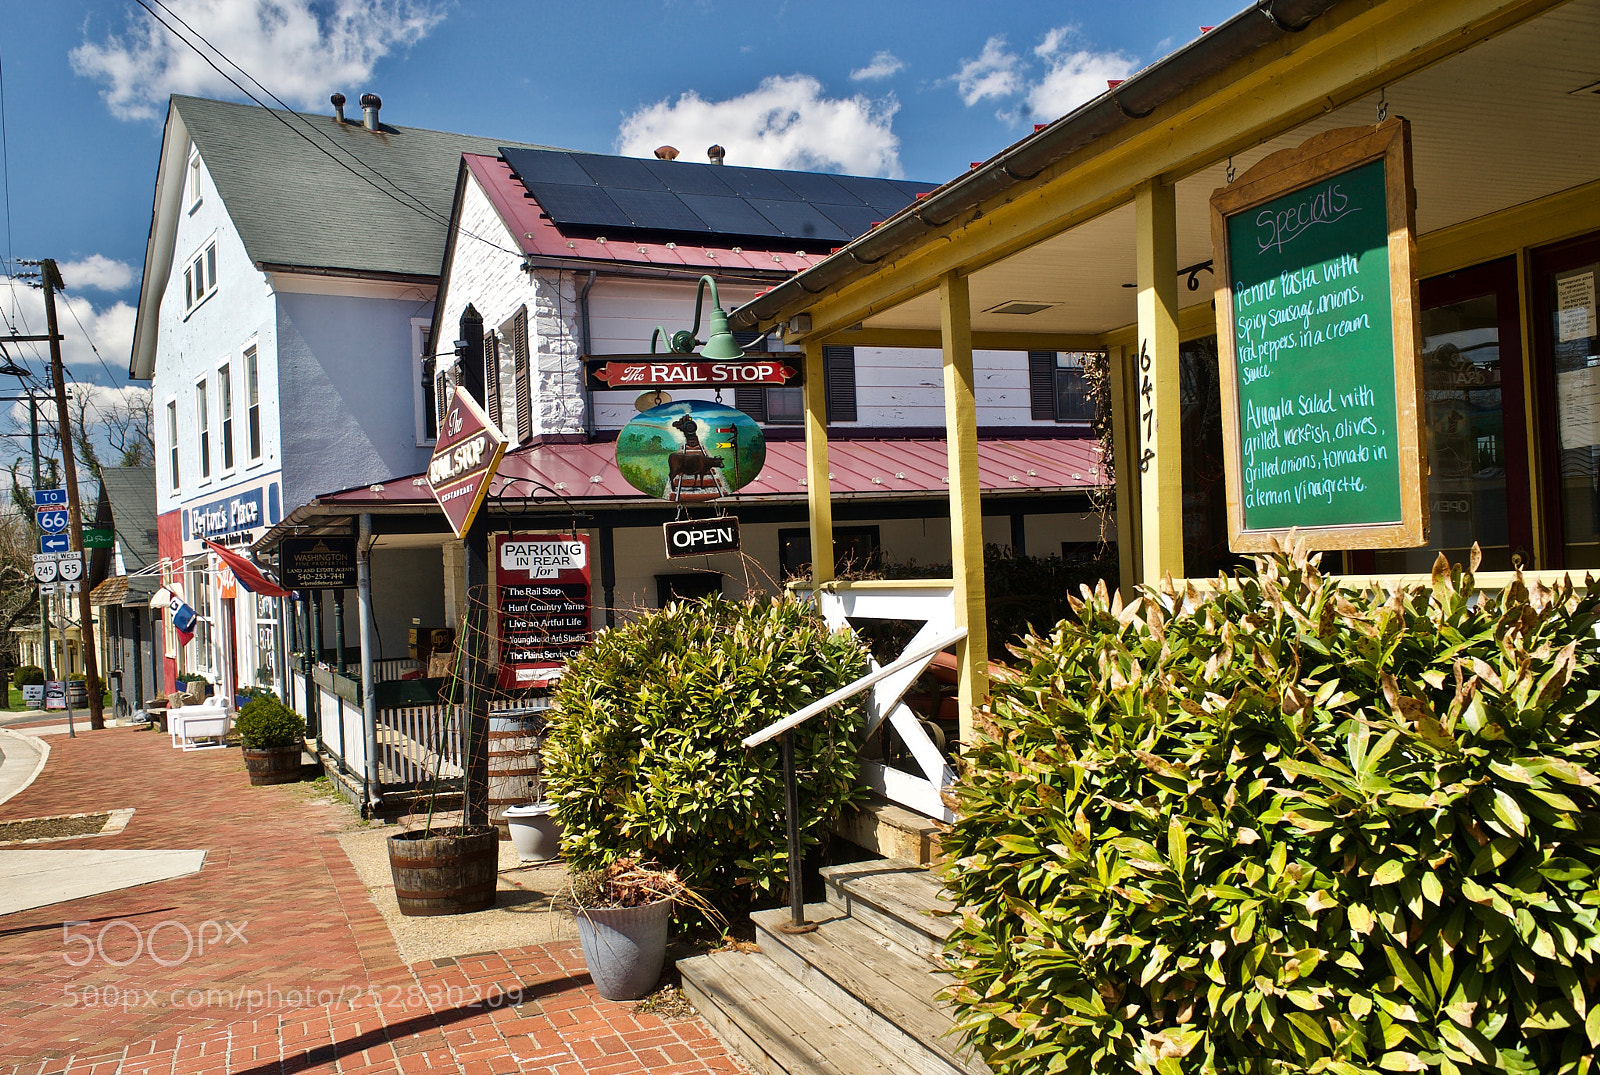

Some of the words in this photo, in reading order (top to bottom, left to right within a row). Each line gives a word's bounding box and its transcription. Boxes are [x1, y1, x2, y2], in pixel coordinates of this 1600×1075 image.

[1255, 183, 1349, 254] Specials
[1236, 281, 1276, 312] Penne
[1279, 269, 1320, 298] Pasta
[1322, 252, 1359, 282] with
[1319, 286, 1364, 314] onions,
[1238, 340, 1258, 364] red
[1300, 331, 1313, 348] in
[1313, 330, 1325, 345] a
[1325, 313, 1371, 340] cream
[620, 366, 647, 383] The
[650, 364, 707, 383] RAIL
[711, 364, 774, 382] STOP
[1139, 338, 1155, 473] 6478
[1246, 397, 1294, 432] Arugula
[1340, 384, 1375, 408] with
[448, 407, 464, 438] The
[454, 436, 487, 474] STOP
[1244, 427, 1281, 467] grilled
[1245, 456, 1279, 491] grilled
[1280, 454, 1321, 475] onions,
[1322, 444, 1369, 469] tomato
[1372, 445, 1387, 461] in
[43, 493, 58, 501] TO
[441, 483, 474, 503] RESTAURANT
[1245, 494, 1255, 509] a
[1256, 488, 1291, 507] lemon
[42, 513, 65, 528] 66
[193, 504, 228, 538] Peyton's
[230, 498, 258, 527] Place
[673, 527, 733, 548] OPEN
[294, 553, 348, 561] WASHINGTON
[505, 544, 582, 556] PARKING
[37, 566, 53, 576] 245
[64, 564, 77, 574] 55
[516, 557, 529, 566] IN
[533, 556, 570, 566] REAR
[535, 566, 554, 578] for
[509, 588, 525, 596] The
[526, 587, 541, 596] Rail
[542, 587, 562, 597] Stop
[508, 604, 528, 612] Hunt
[530, 603, 562, 613] Country
[563, 602, 585, 611] Yarns
[509, 619, 527, 628] Live
[541, 618, 564, 627] Artful
[566, 617, 582, 626] Life
[510, 651, 523, 660] The
[523, 650, 543, 659] Plains
[544, 650, 569, 659] Service
